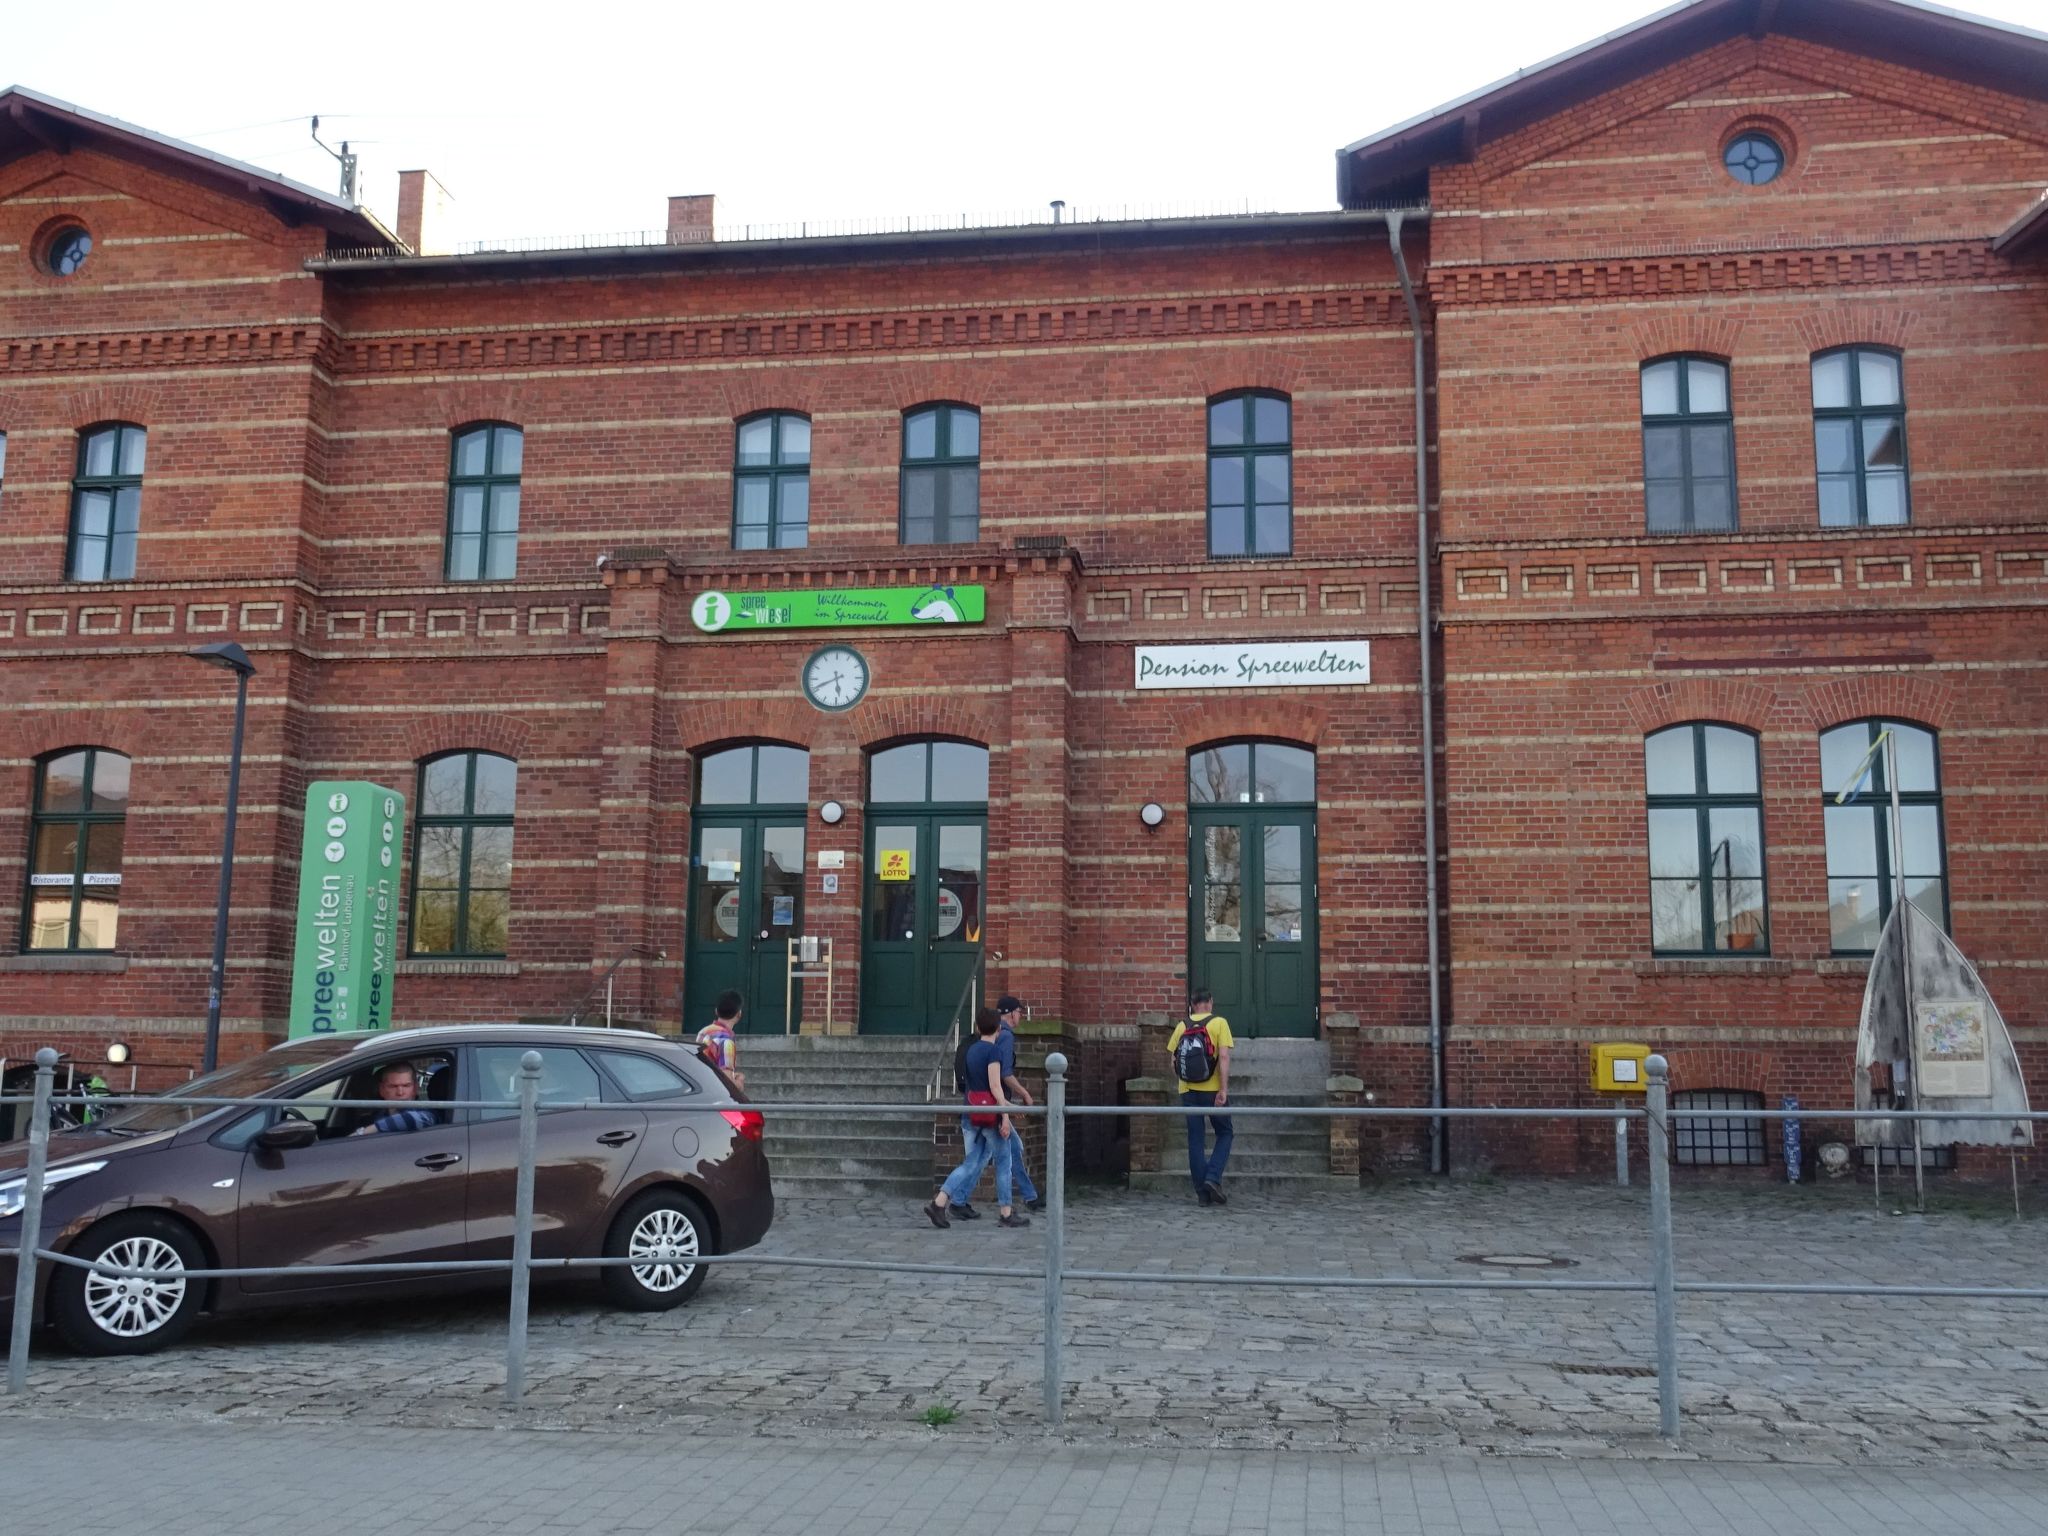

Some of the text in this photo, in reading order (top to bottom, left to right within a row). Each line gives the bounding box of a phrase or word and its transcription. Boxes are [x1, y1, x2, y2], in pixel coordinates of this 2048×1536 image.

[741, 596, 766, 611] spree
[817, 593, 888, 608] Willkommen
[756, 605, 792, 624] wiesel
[815, 607, 889, 622] im Spreewald
[1140, 649, 1366, 682] Pension Spreewelten
[33, 875, 121, 884] Ristorante Pizzeria
[882, 869, 907, 877] LOTTO
[312, 875, 341, 1033] preewelten
